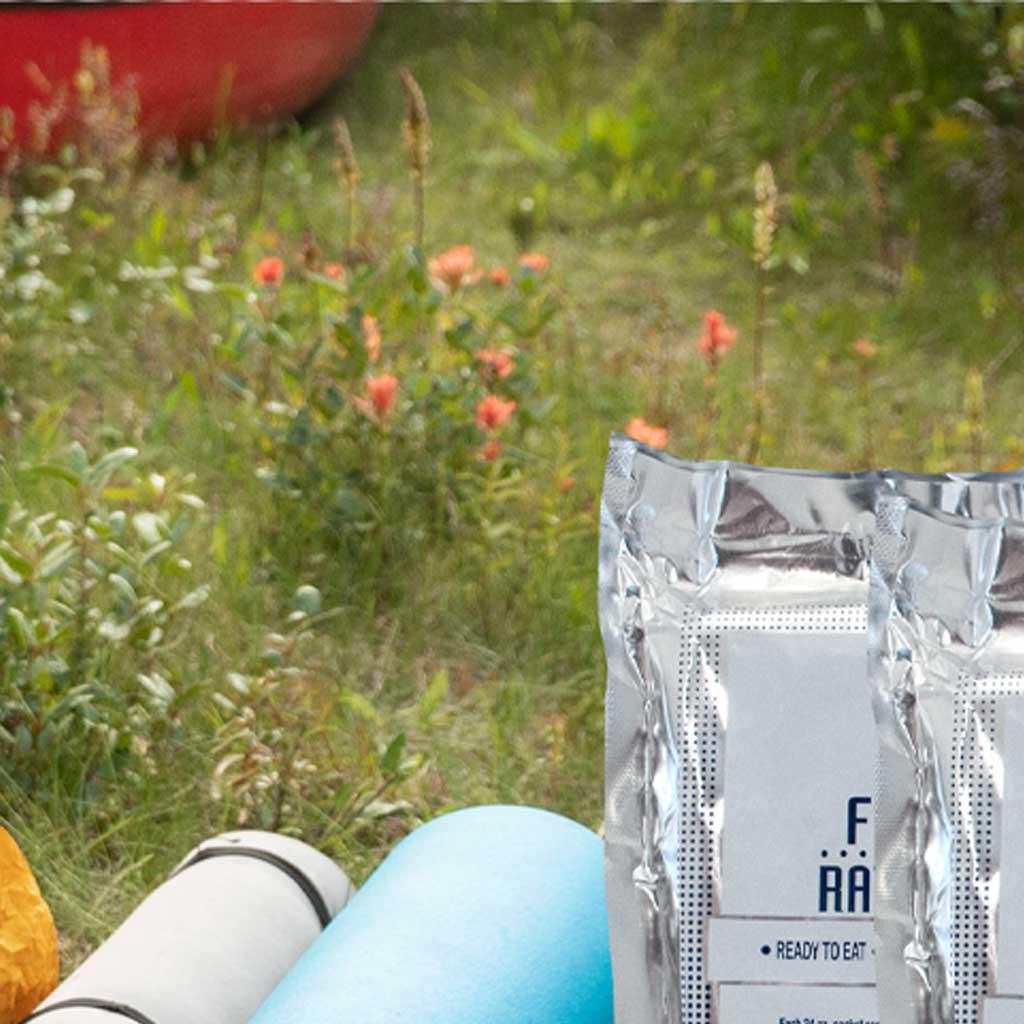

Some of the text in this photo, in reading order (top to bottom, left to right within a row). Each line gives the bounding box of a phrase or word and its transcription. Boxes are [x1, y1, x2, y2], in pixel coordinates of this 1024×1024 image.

[776, 941, 867, 960] READY TO EAT
